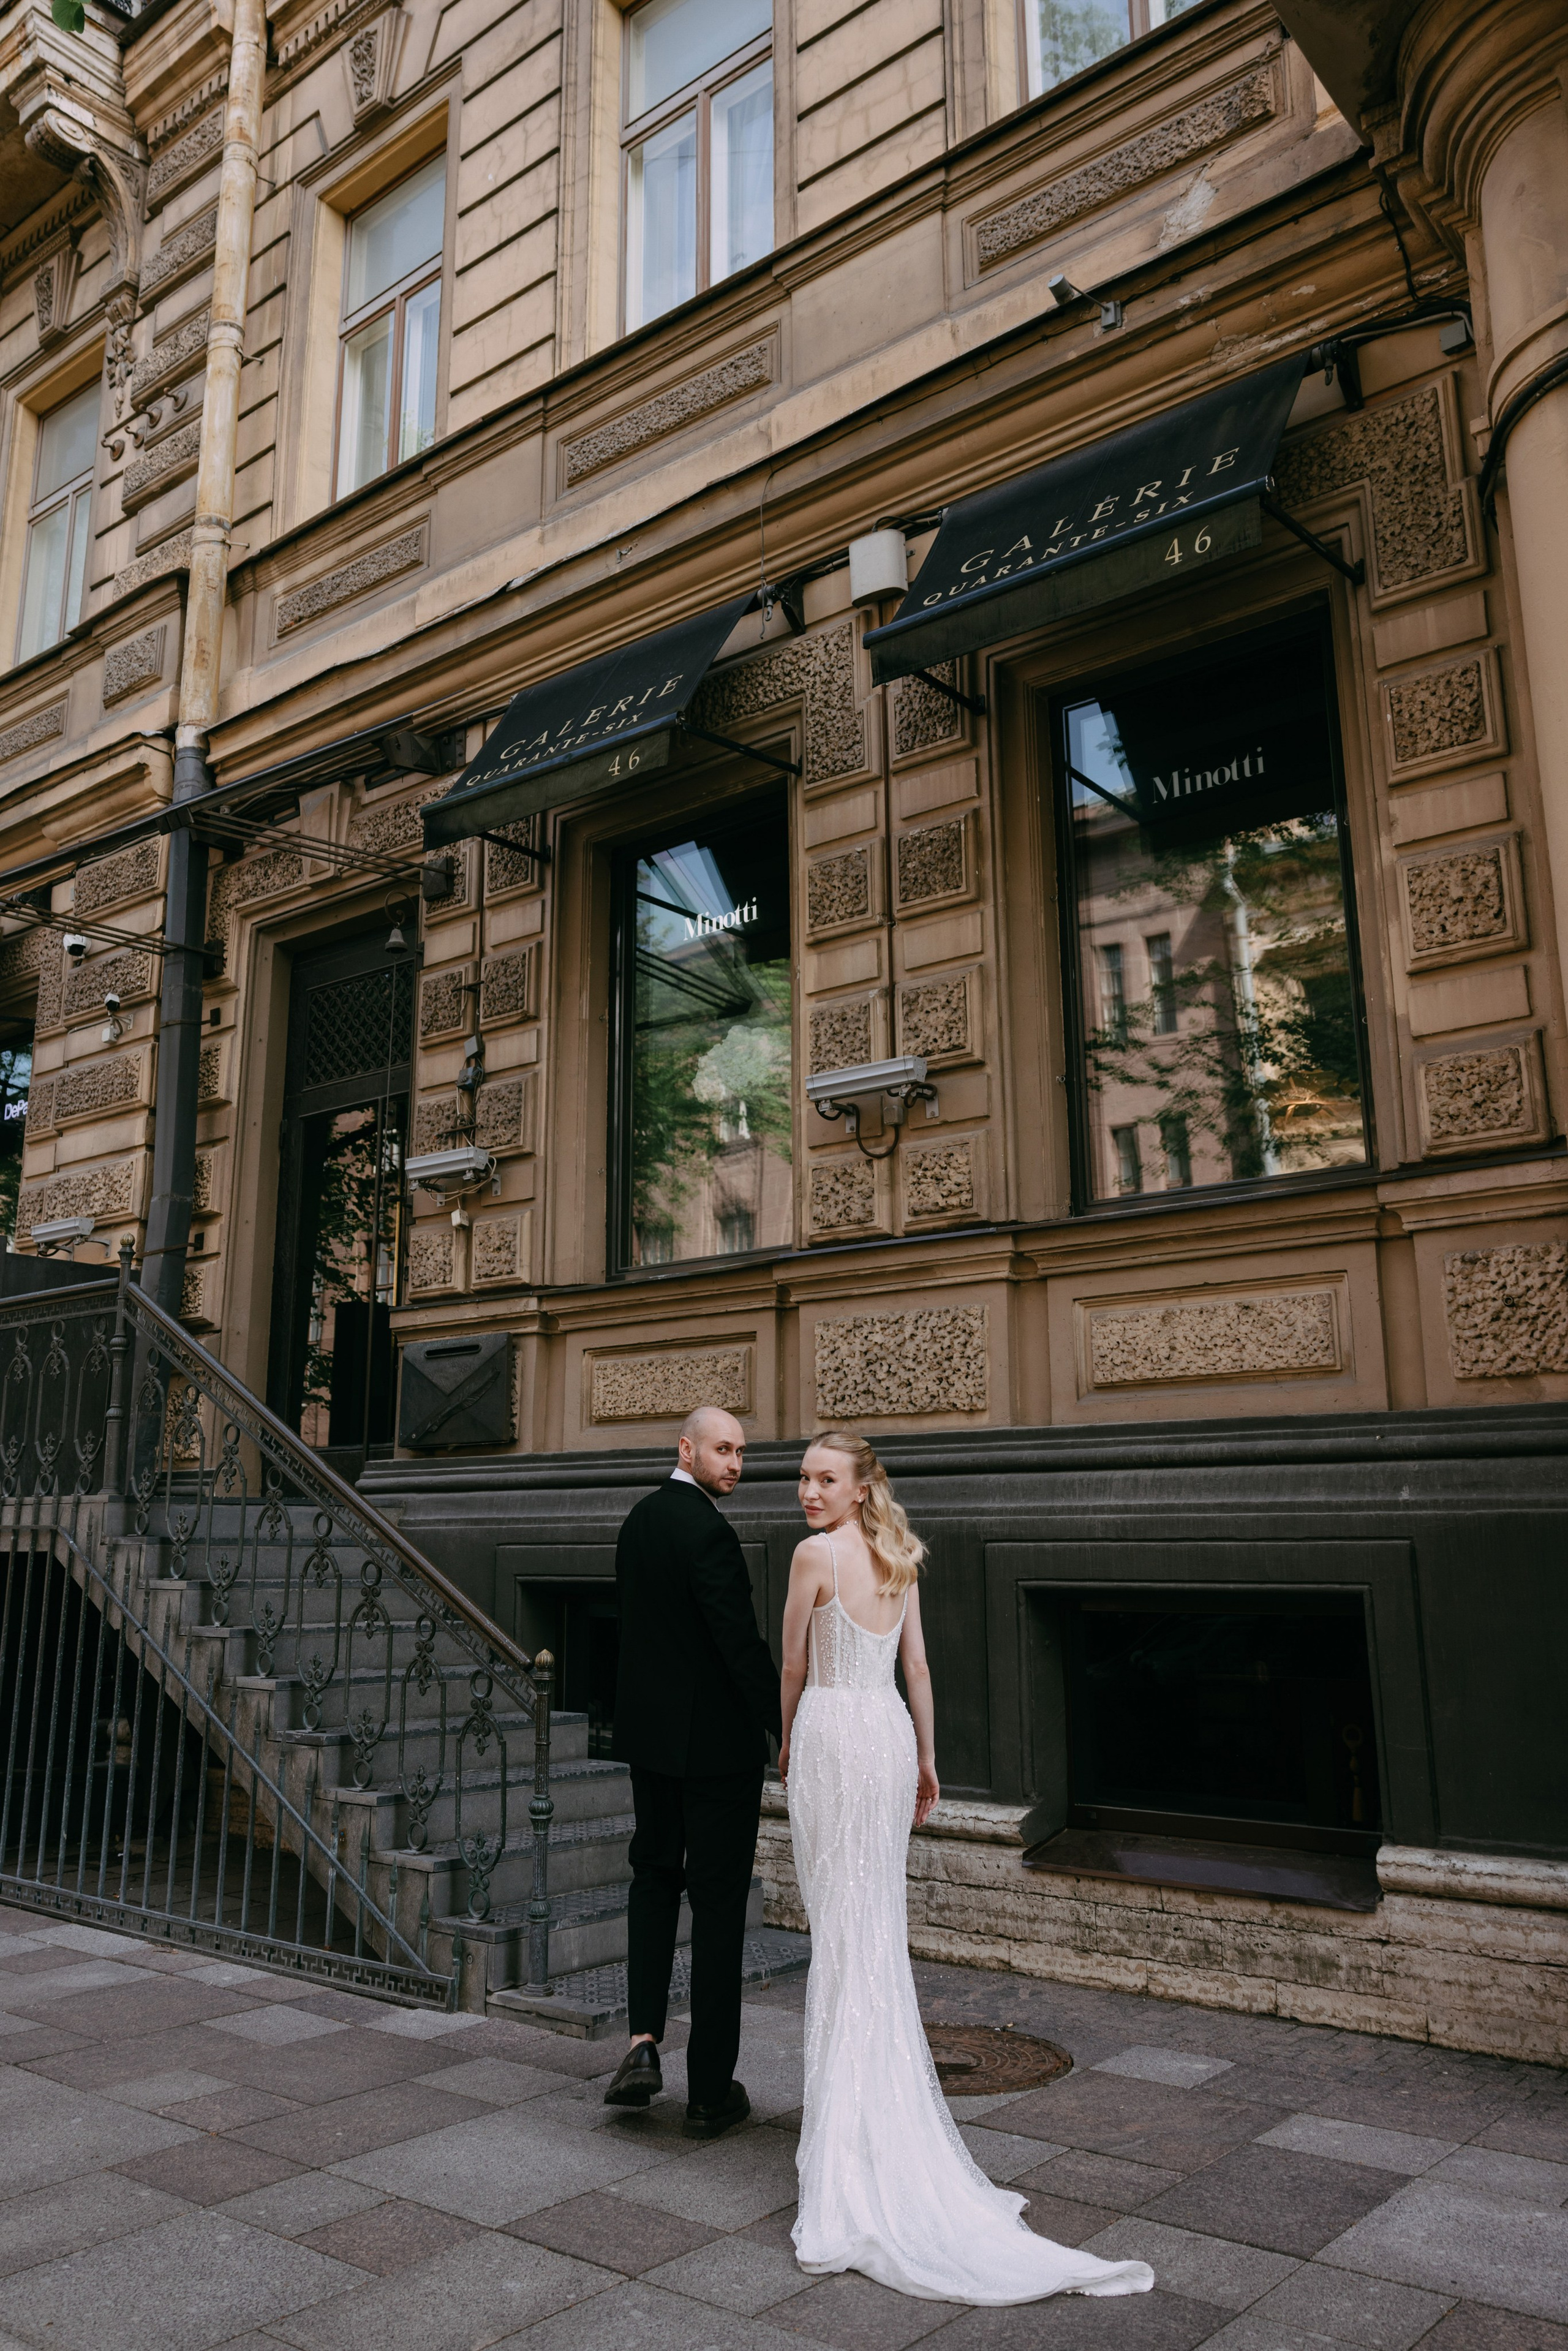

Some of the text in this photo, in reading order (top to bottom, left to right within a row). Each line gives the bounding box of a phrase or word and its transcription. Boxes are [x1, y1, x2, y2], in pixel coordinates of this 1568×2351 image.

[960, 447, 1240, 574] GALERIE
[922, 492, 1194, 606] QUARANTE-SIX
[1164, 525, 1212, 565] 46
[466, 712, 643, 787] QUARANTE-SIX
[500, 674, 684, 760] GALERIE
[608, 747, 640, 776] 46
[1152, 746, 1265, 804] Minotti
[683, 897, 758, 941] Minotti
